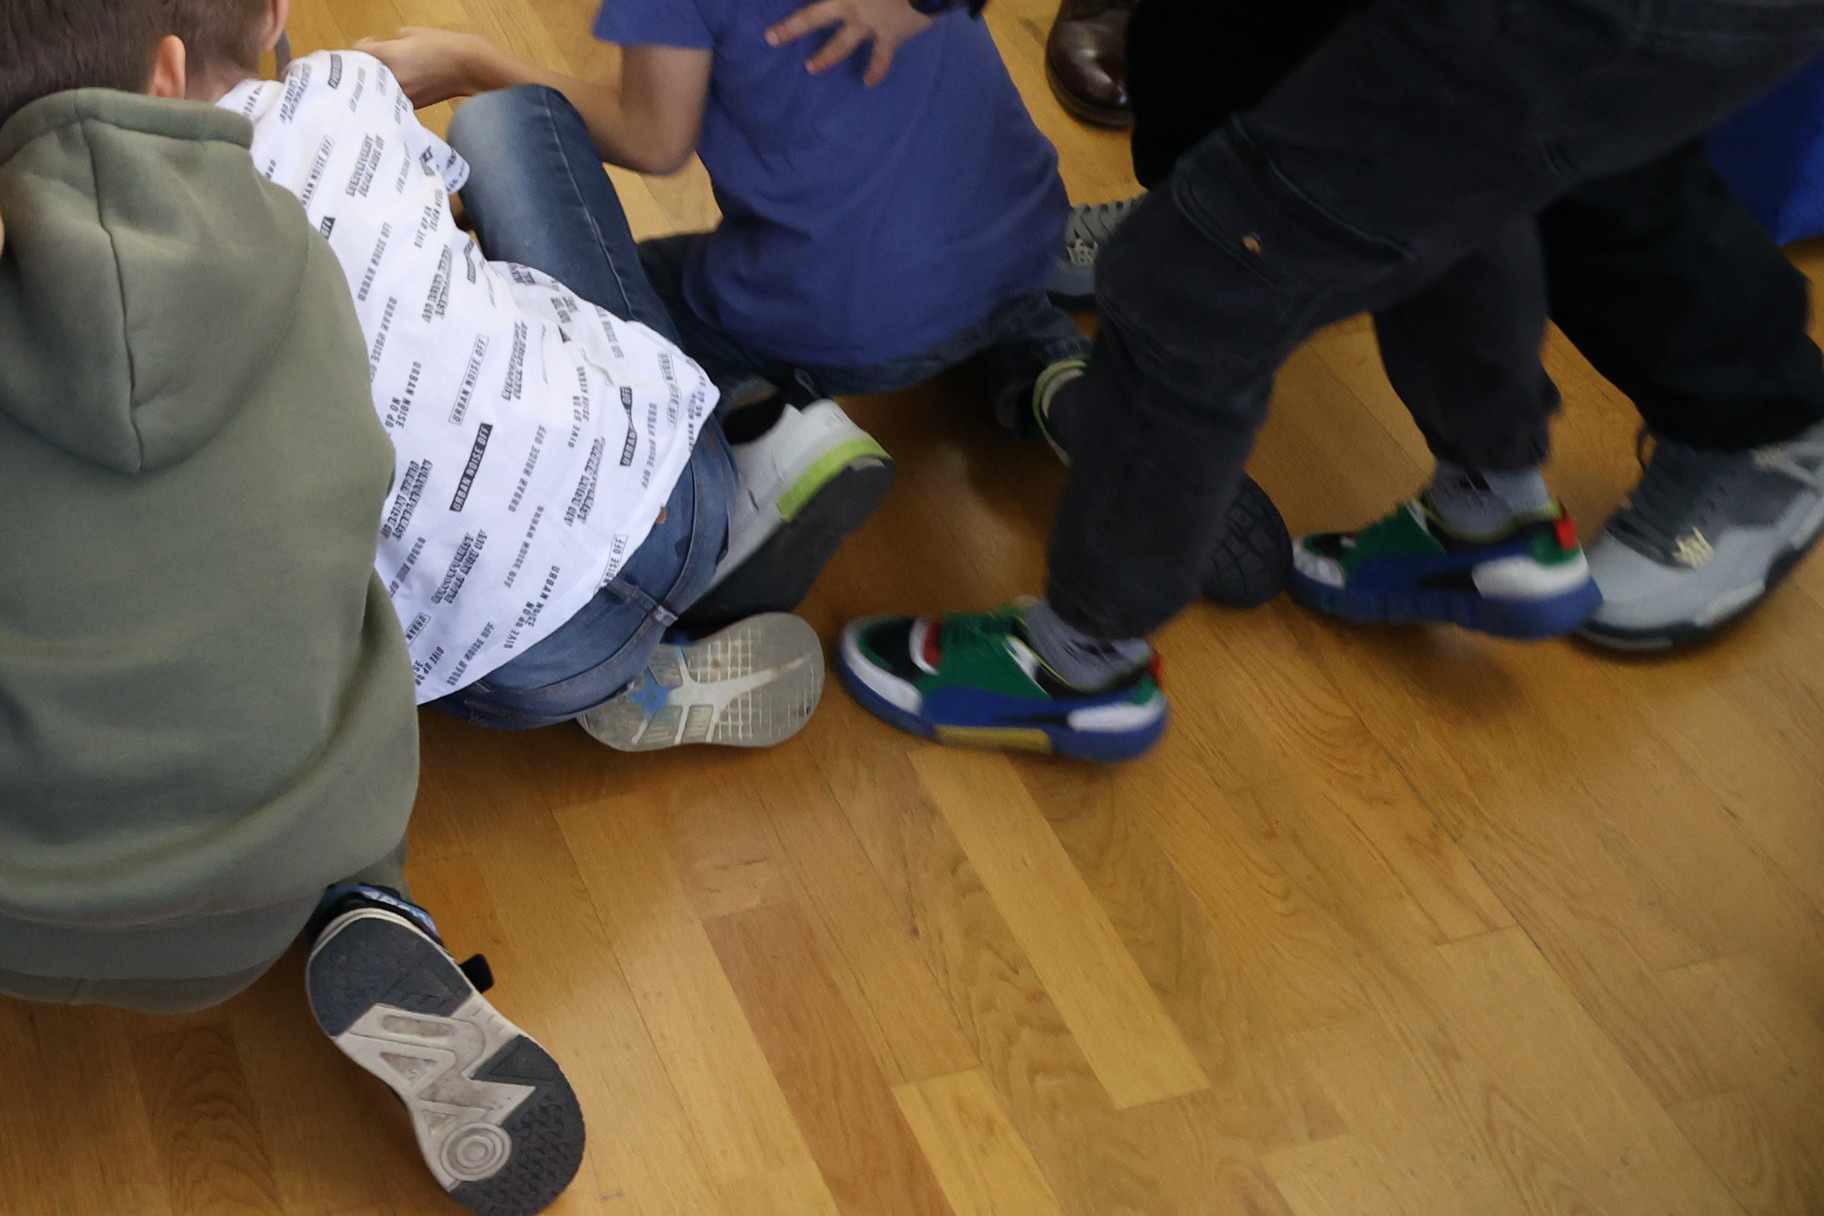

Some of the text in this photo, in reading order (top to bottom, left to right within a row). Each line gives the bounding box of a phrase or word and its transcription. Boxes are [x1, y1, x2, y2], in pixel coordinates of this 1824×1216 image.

[310, 156, 325, 180] NOISE
[321, 139, 332, 155] OFF
[395, 362, 421, 428] URBAN NOISE
[452, 338, 485, 422] URBAN NOISE OFF
[385, 397, 400, 428] UP ON
[451, 425, 491, 511] URBAN NOISE OFF
[523, 446, 540, 477] NOISE
[534, 424, 547, 445] OFF
[612, 538, 624, 554] OFF
[540, 565, 560, 600] URBAN
[406, 615, 426, 640] URBAN
[503, 629, 519, 649] GIVE
[523, 601, 534, 615] ON
